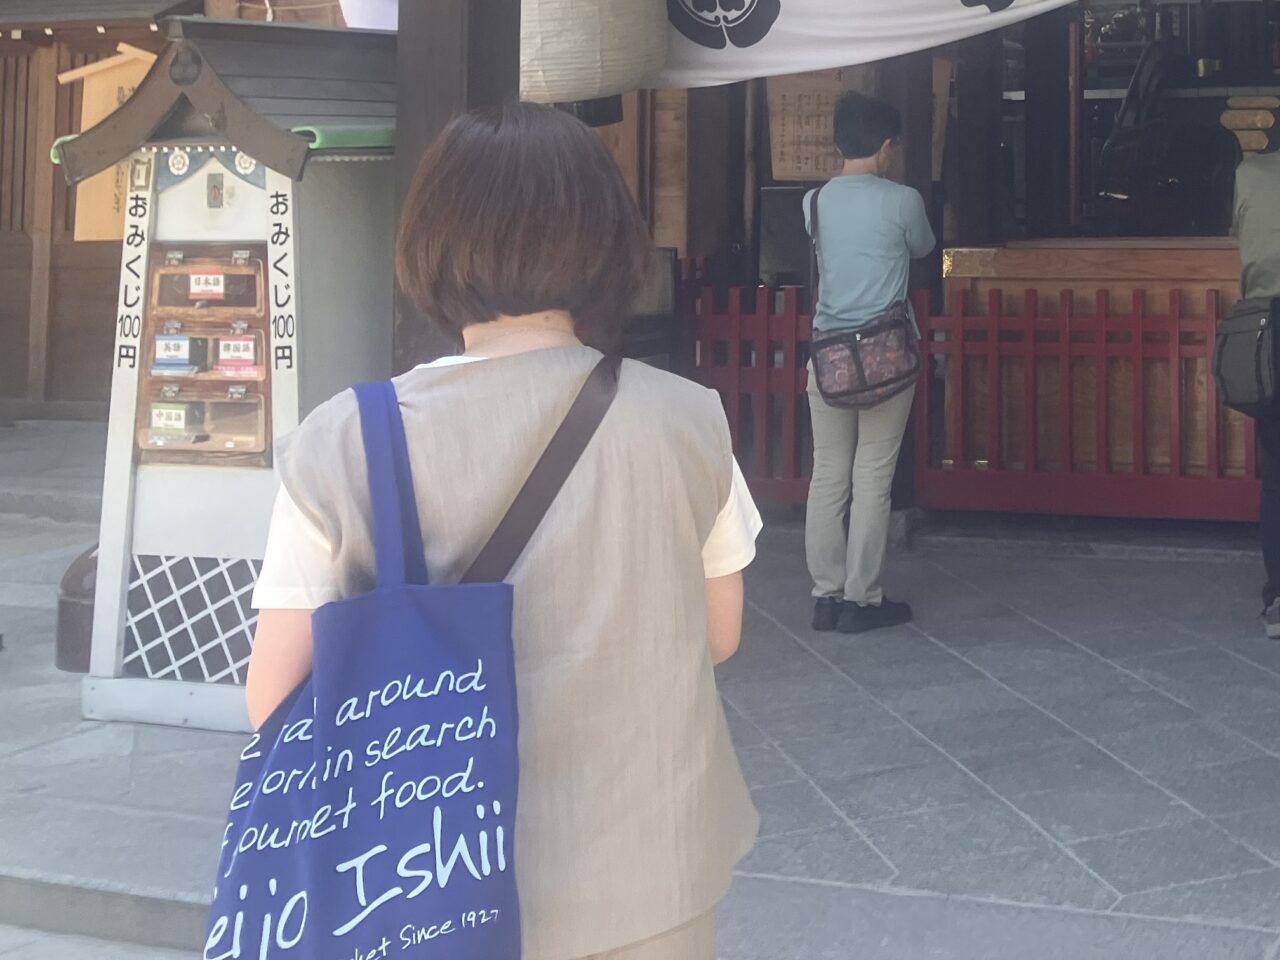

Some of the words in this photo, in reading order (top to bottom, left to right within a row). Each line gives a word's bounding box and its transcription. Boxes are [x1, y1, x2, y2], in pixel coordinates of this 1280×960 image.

[117, 194, 147, 368] おみくじ100円
[269, 191, 295, 370] おみくじ100円
[335, 658, 487, 727] around
[322, 746, 354, 782] in
[364, 705, 497, 767] search
[371, 756, 486, 820] food.
[202, 877, 308, 960] eijo
[332, 799, 507, 937] Ishii
[399, 924, 456, 950] Since
[461, 909, 499, 928] 1927
